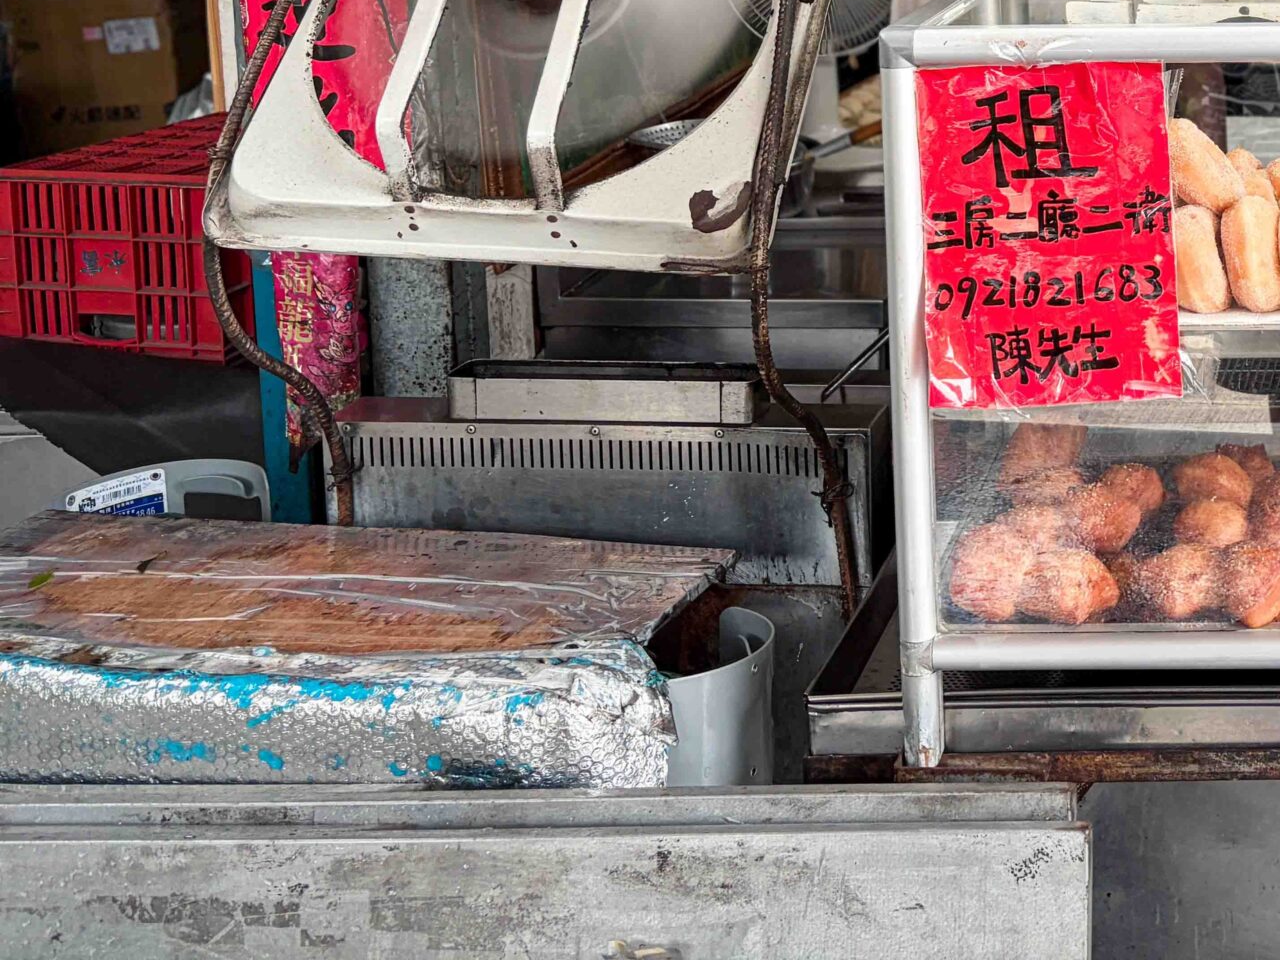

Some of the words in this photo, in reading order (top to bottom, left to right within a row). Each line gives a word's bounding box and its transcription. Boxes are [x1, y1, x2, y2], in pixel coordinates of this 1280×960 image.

[961, 85, 1099, 188] 租
[934, 264, 1164, 320] 0921821683
[984, 323, 1119, 385] 陳先生
